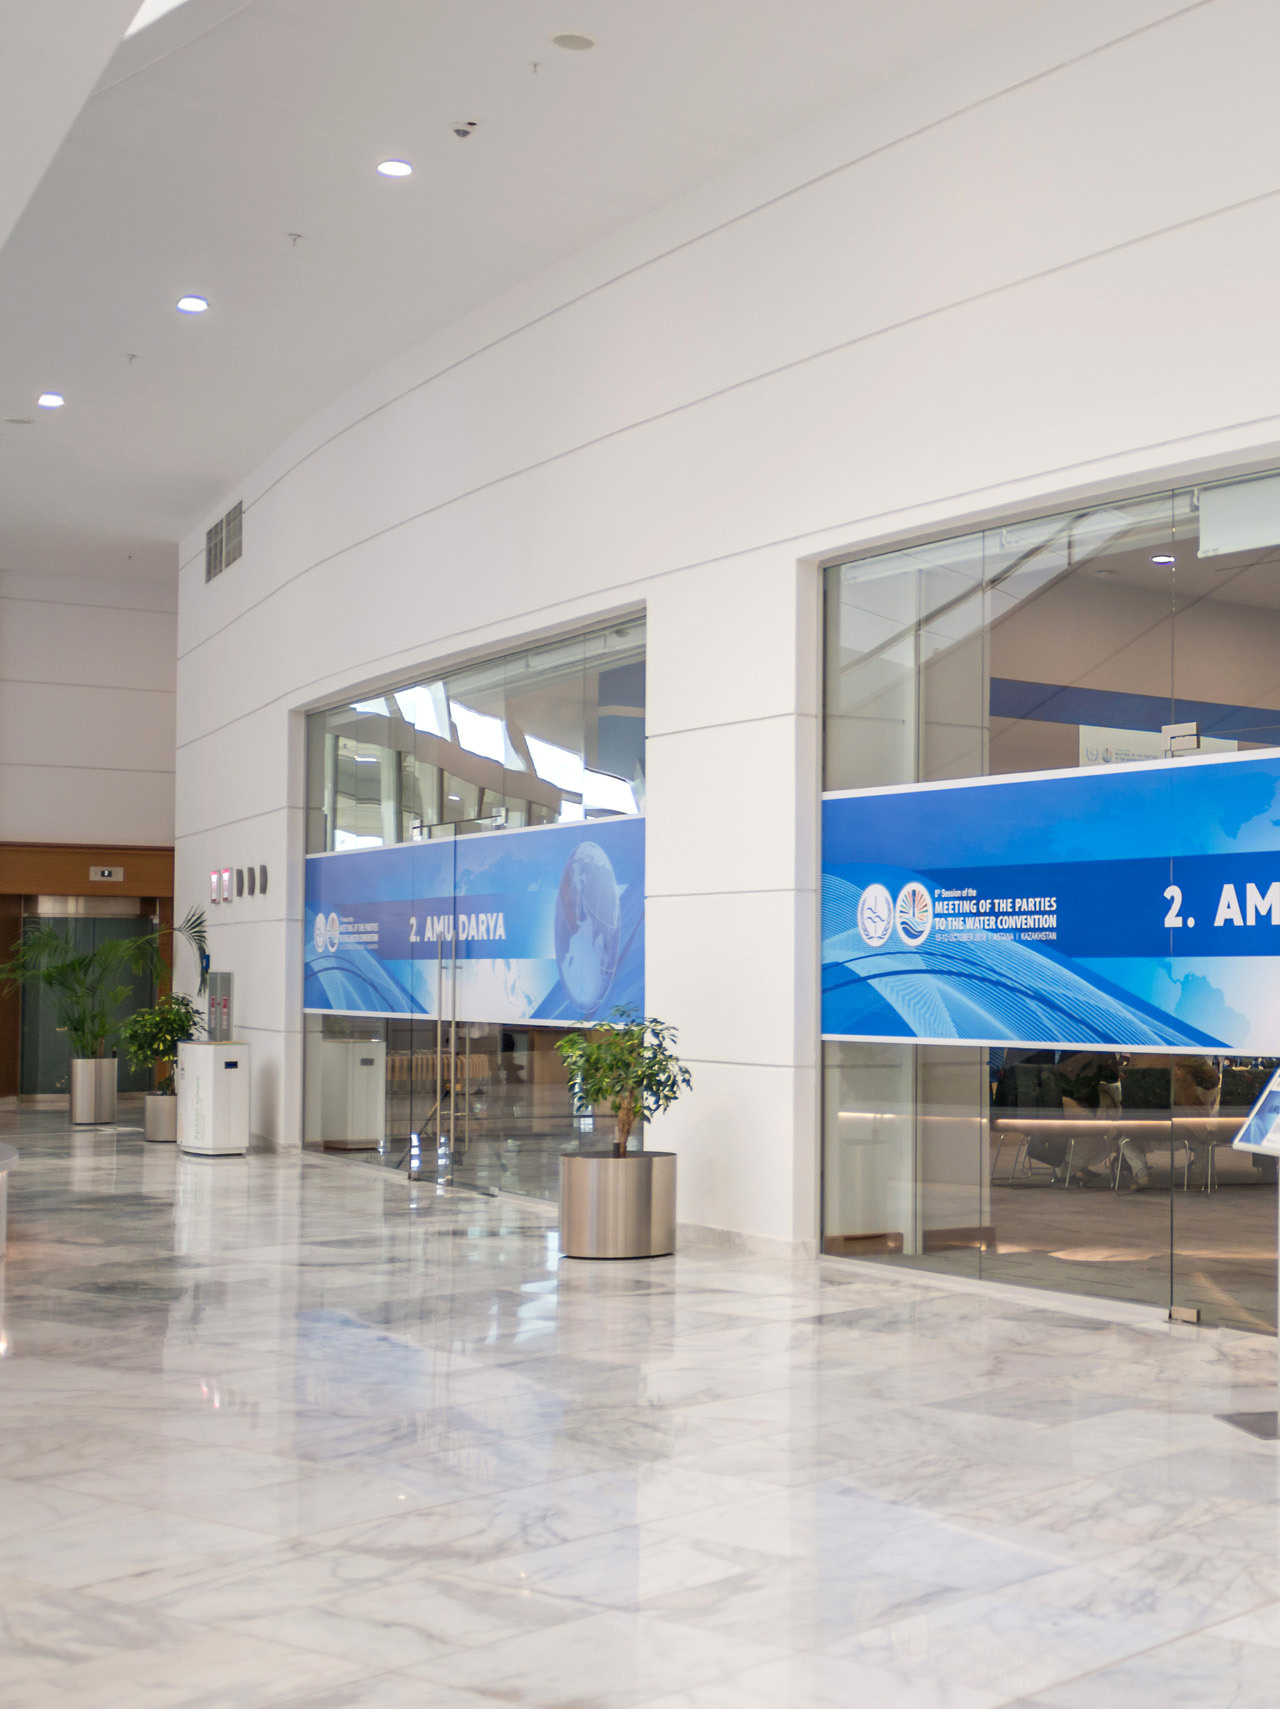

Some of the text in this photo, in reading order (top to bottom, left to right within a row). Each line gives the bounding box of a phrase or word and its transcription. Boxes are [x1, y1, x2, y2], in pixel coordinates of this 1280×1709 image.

[941, 888, 962, 898] Session
[962, 888, 968, 897] of
[968, 888, 977, 897] the
[934, 897, 1057, 914] MEETING OF THE PARTIES
[1164, 885, 1196, 929] 2.
[409, 912, 506, 942] 2. AMU DARYA
[935, 915, 1057, 930] TO THE WATER CONVENTION
[993, 932, 1014, 941] ASTANA
[1021, 931, 1057, 941] KAZAKHSTAN
